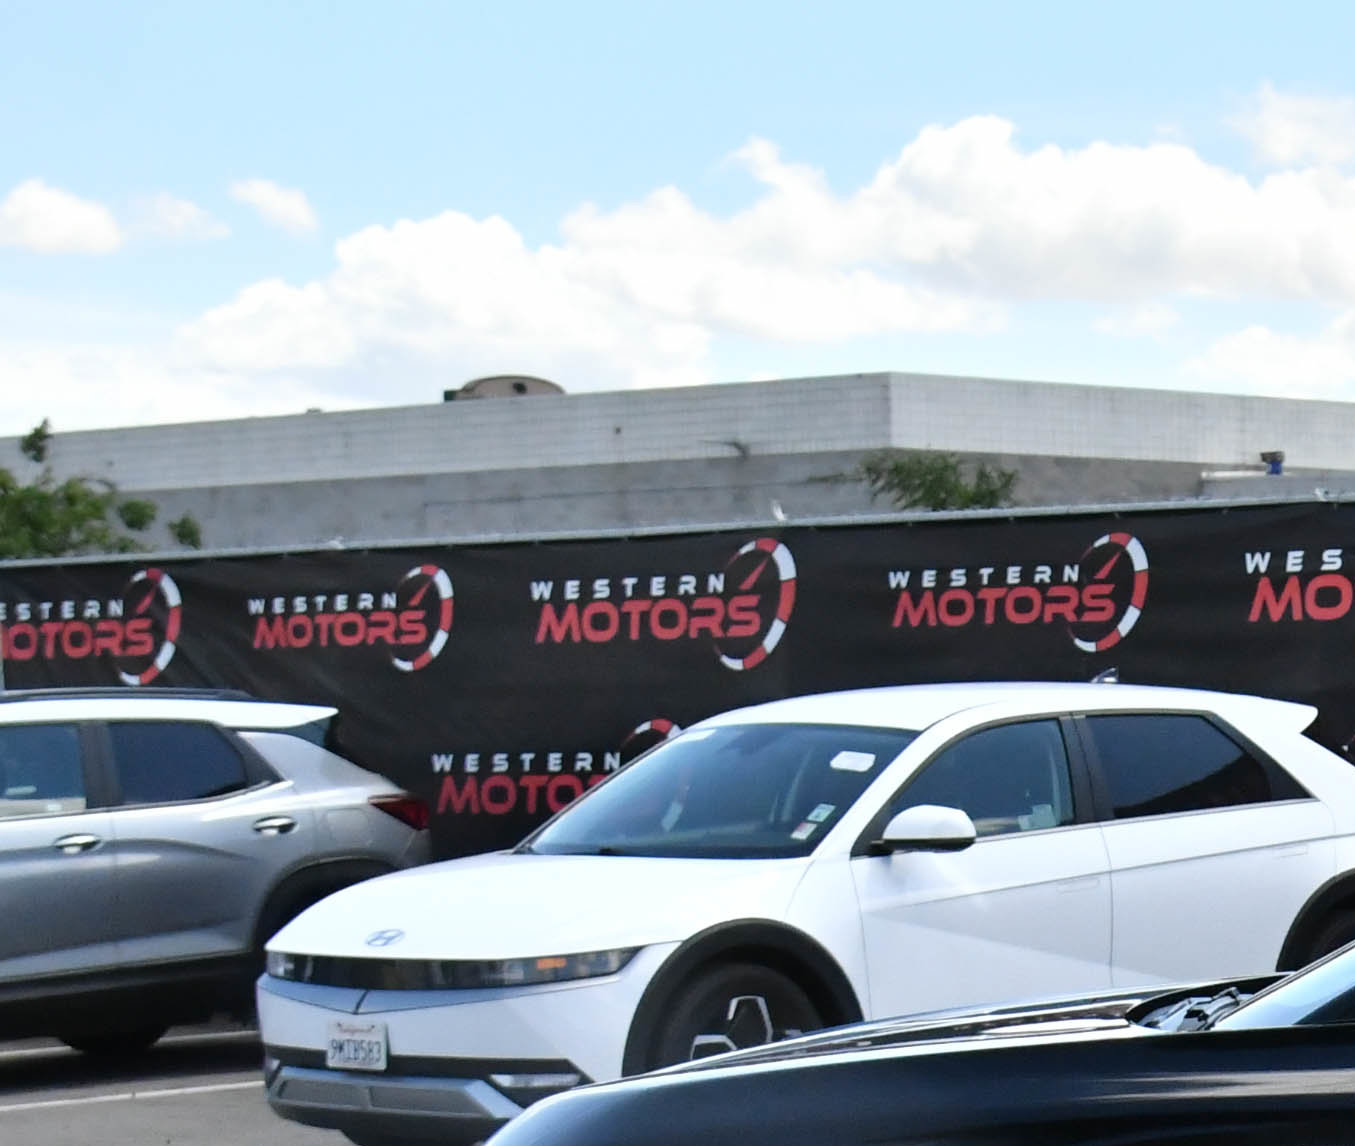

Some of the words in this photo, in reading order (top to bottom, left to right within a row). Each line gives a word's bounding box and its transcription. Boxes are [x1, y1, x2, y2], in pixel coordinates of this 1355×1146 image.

[530, 573, 725, 601] WESTERN
[888, 564, 1079, 589] WESTERN
[248, 592, 397, 614] WESTERN
[892, 583, 1116, 627] MOTORS
[253, 609, 428, 649] MOTORS
[535, 594, 761, 644] MOTORS
[432, 751, 622, 773] WESTERN
